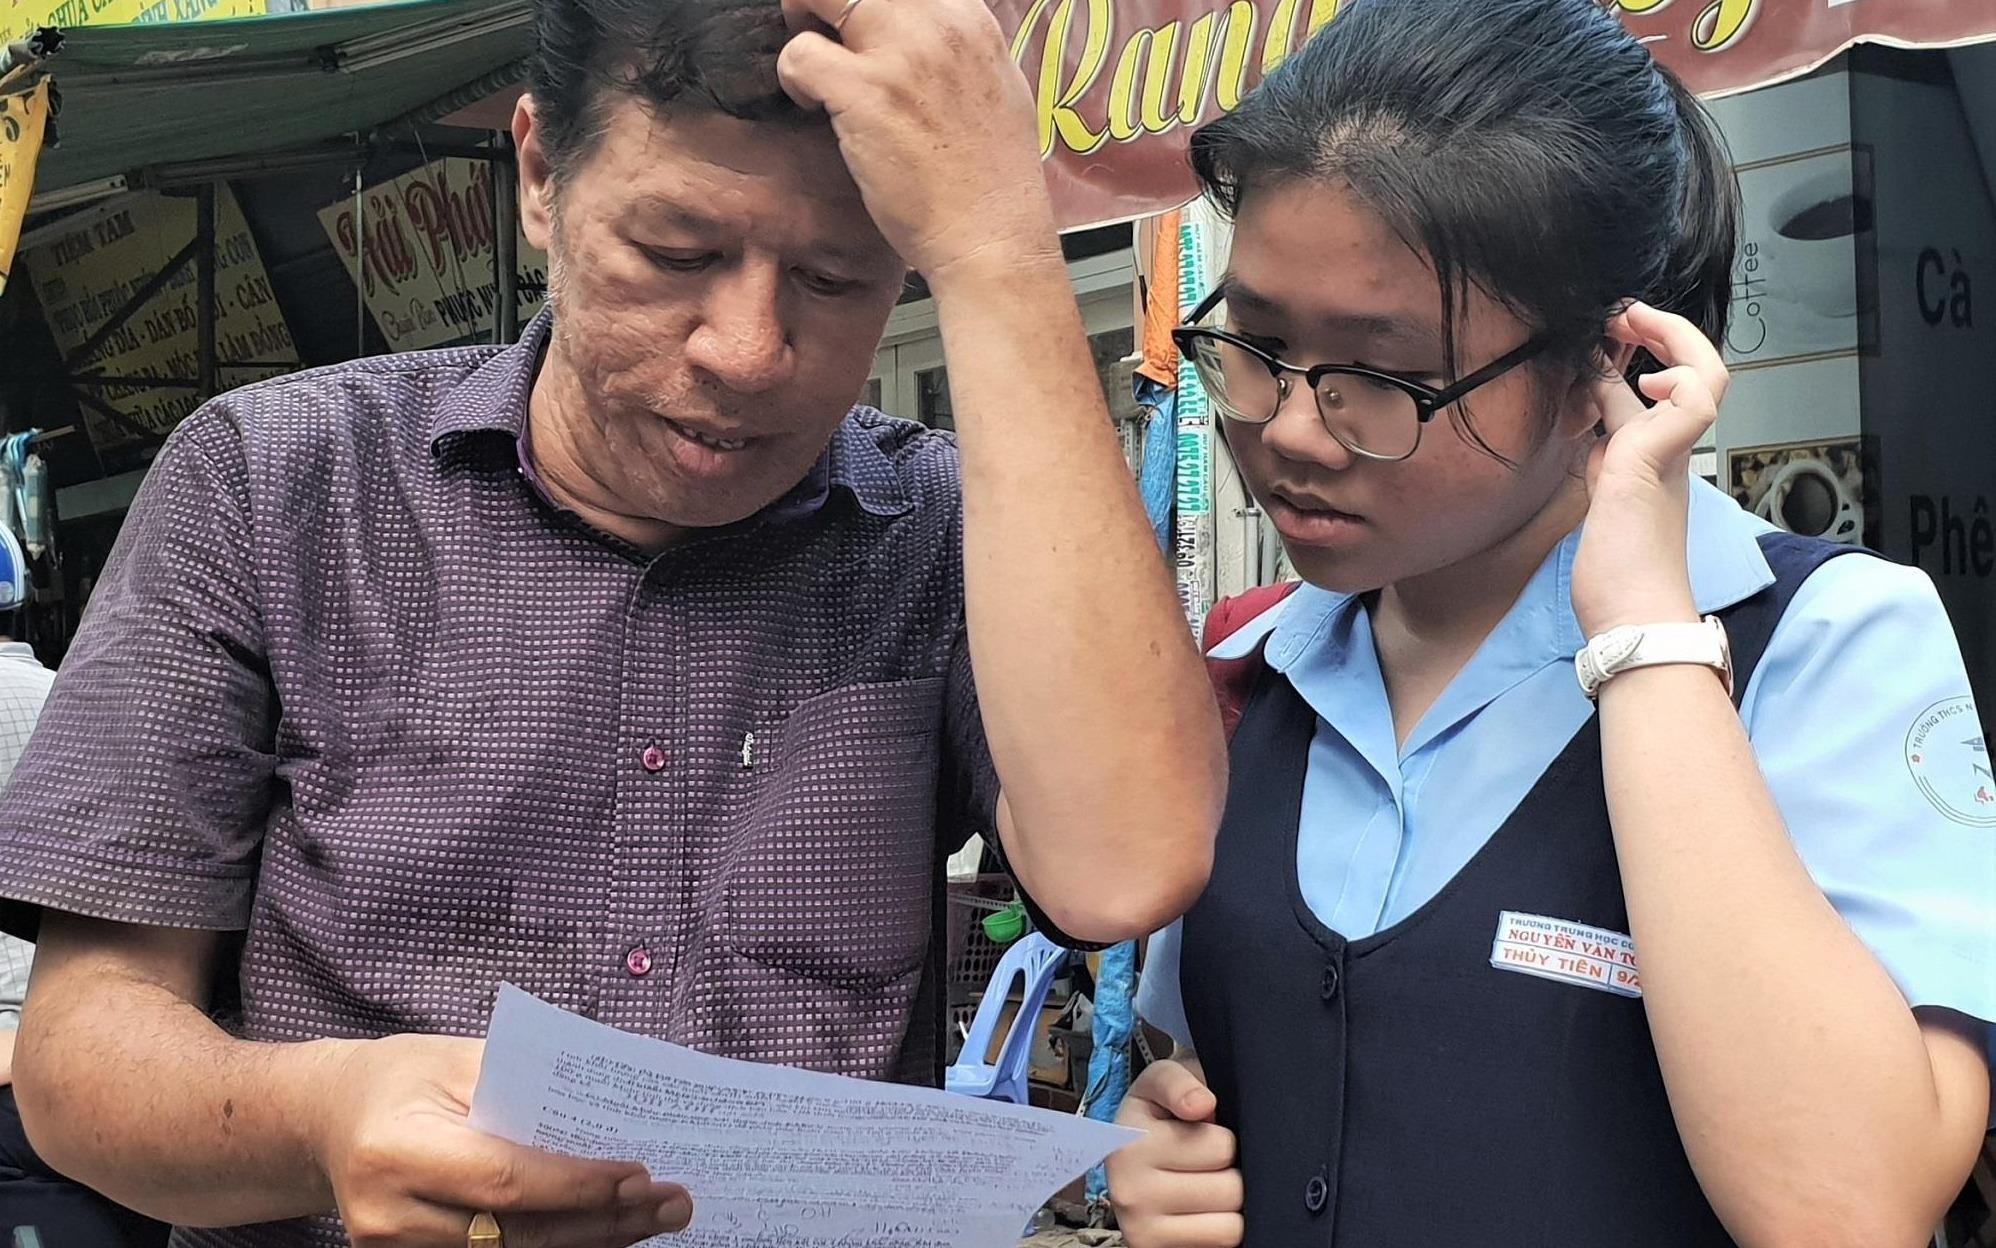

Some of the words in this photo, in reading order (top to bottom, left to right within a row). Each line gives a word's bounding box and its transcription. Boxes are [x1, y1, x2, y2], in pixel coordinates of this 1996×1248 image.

[1727, 241, 1768, 355] Coffee
[1916, 246, 1974, 329] Cà
[1910, 494, 1995, 579] Phê
[1508, 929, 1577, 951] NGUYỄN
[1582, 940, 1616, 961] VĂN
[1554, 924, 1593, 940] TRUNG
[1502, 947, 1551, 966] THỦY
[1558, 957, 1603, 979] TIÊN
